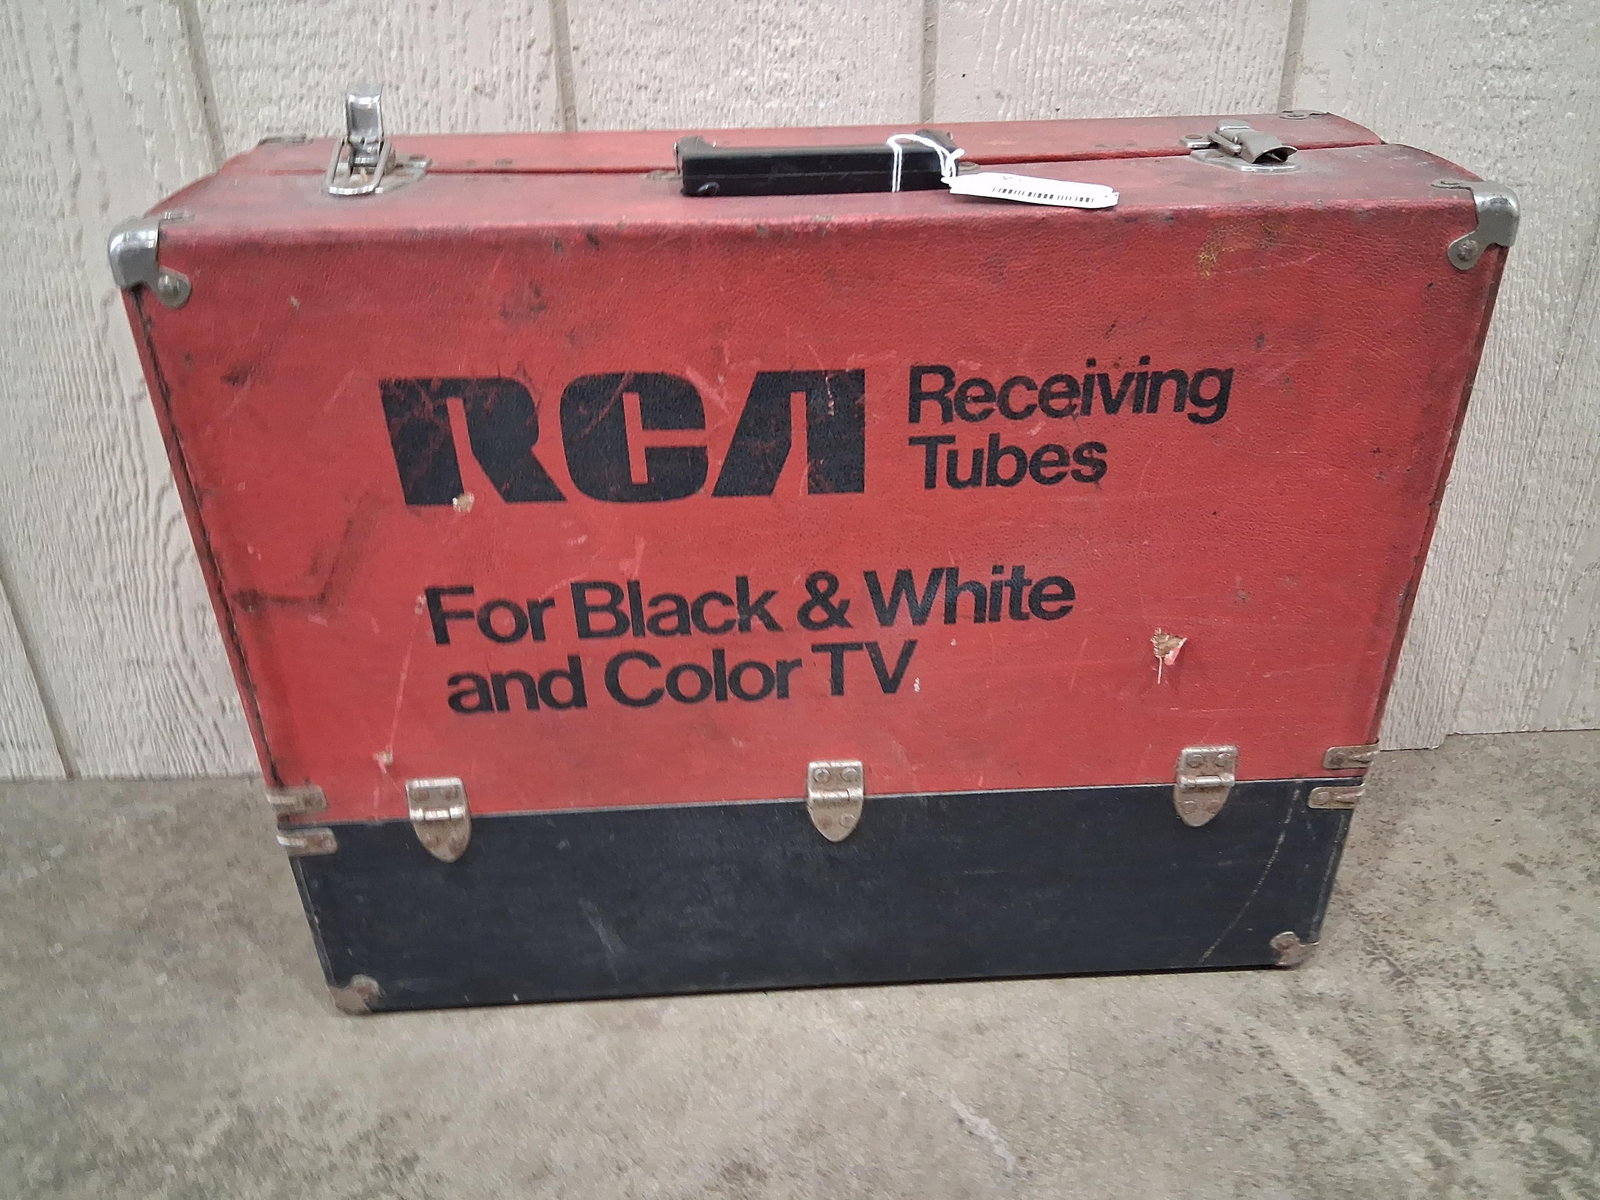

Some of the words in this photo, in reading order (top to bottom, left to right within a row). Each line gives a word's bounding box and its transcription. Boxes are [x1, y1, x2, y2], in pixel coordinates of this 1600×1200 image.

[907, 355, 1235, 424] Receiving
[379, 368, 866, 506] RCA
[908, 432, 1108, 490] Tubes
[424, 585, 556, 645] For
[570, 574, 784, 640] Black
[797, 570, 853, 632] &
[863, 565, 1077, 627] White
[446, 654, 589, 715] and
[604, 648, 803, 708] Color
[811, 639, 918, 697] TV
